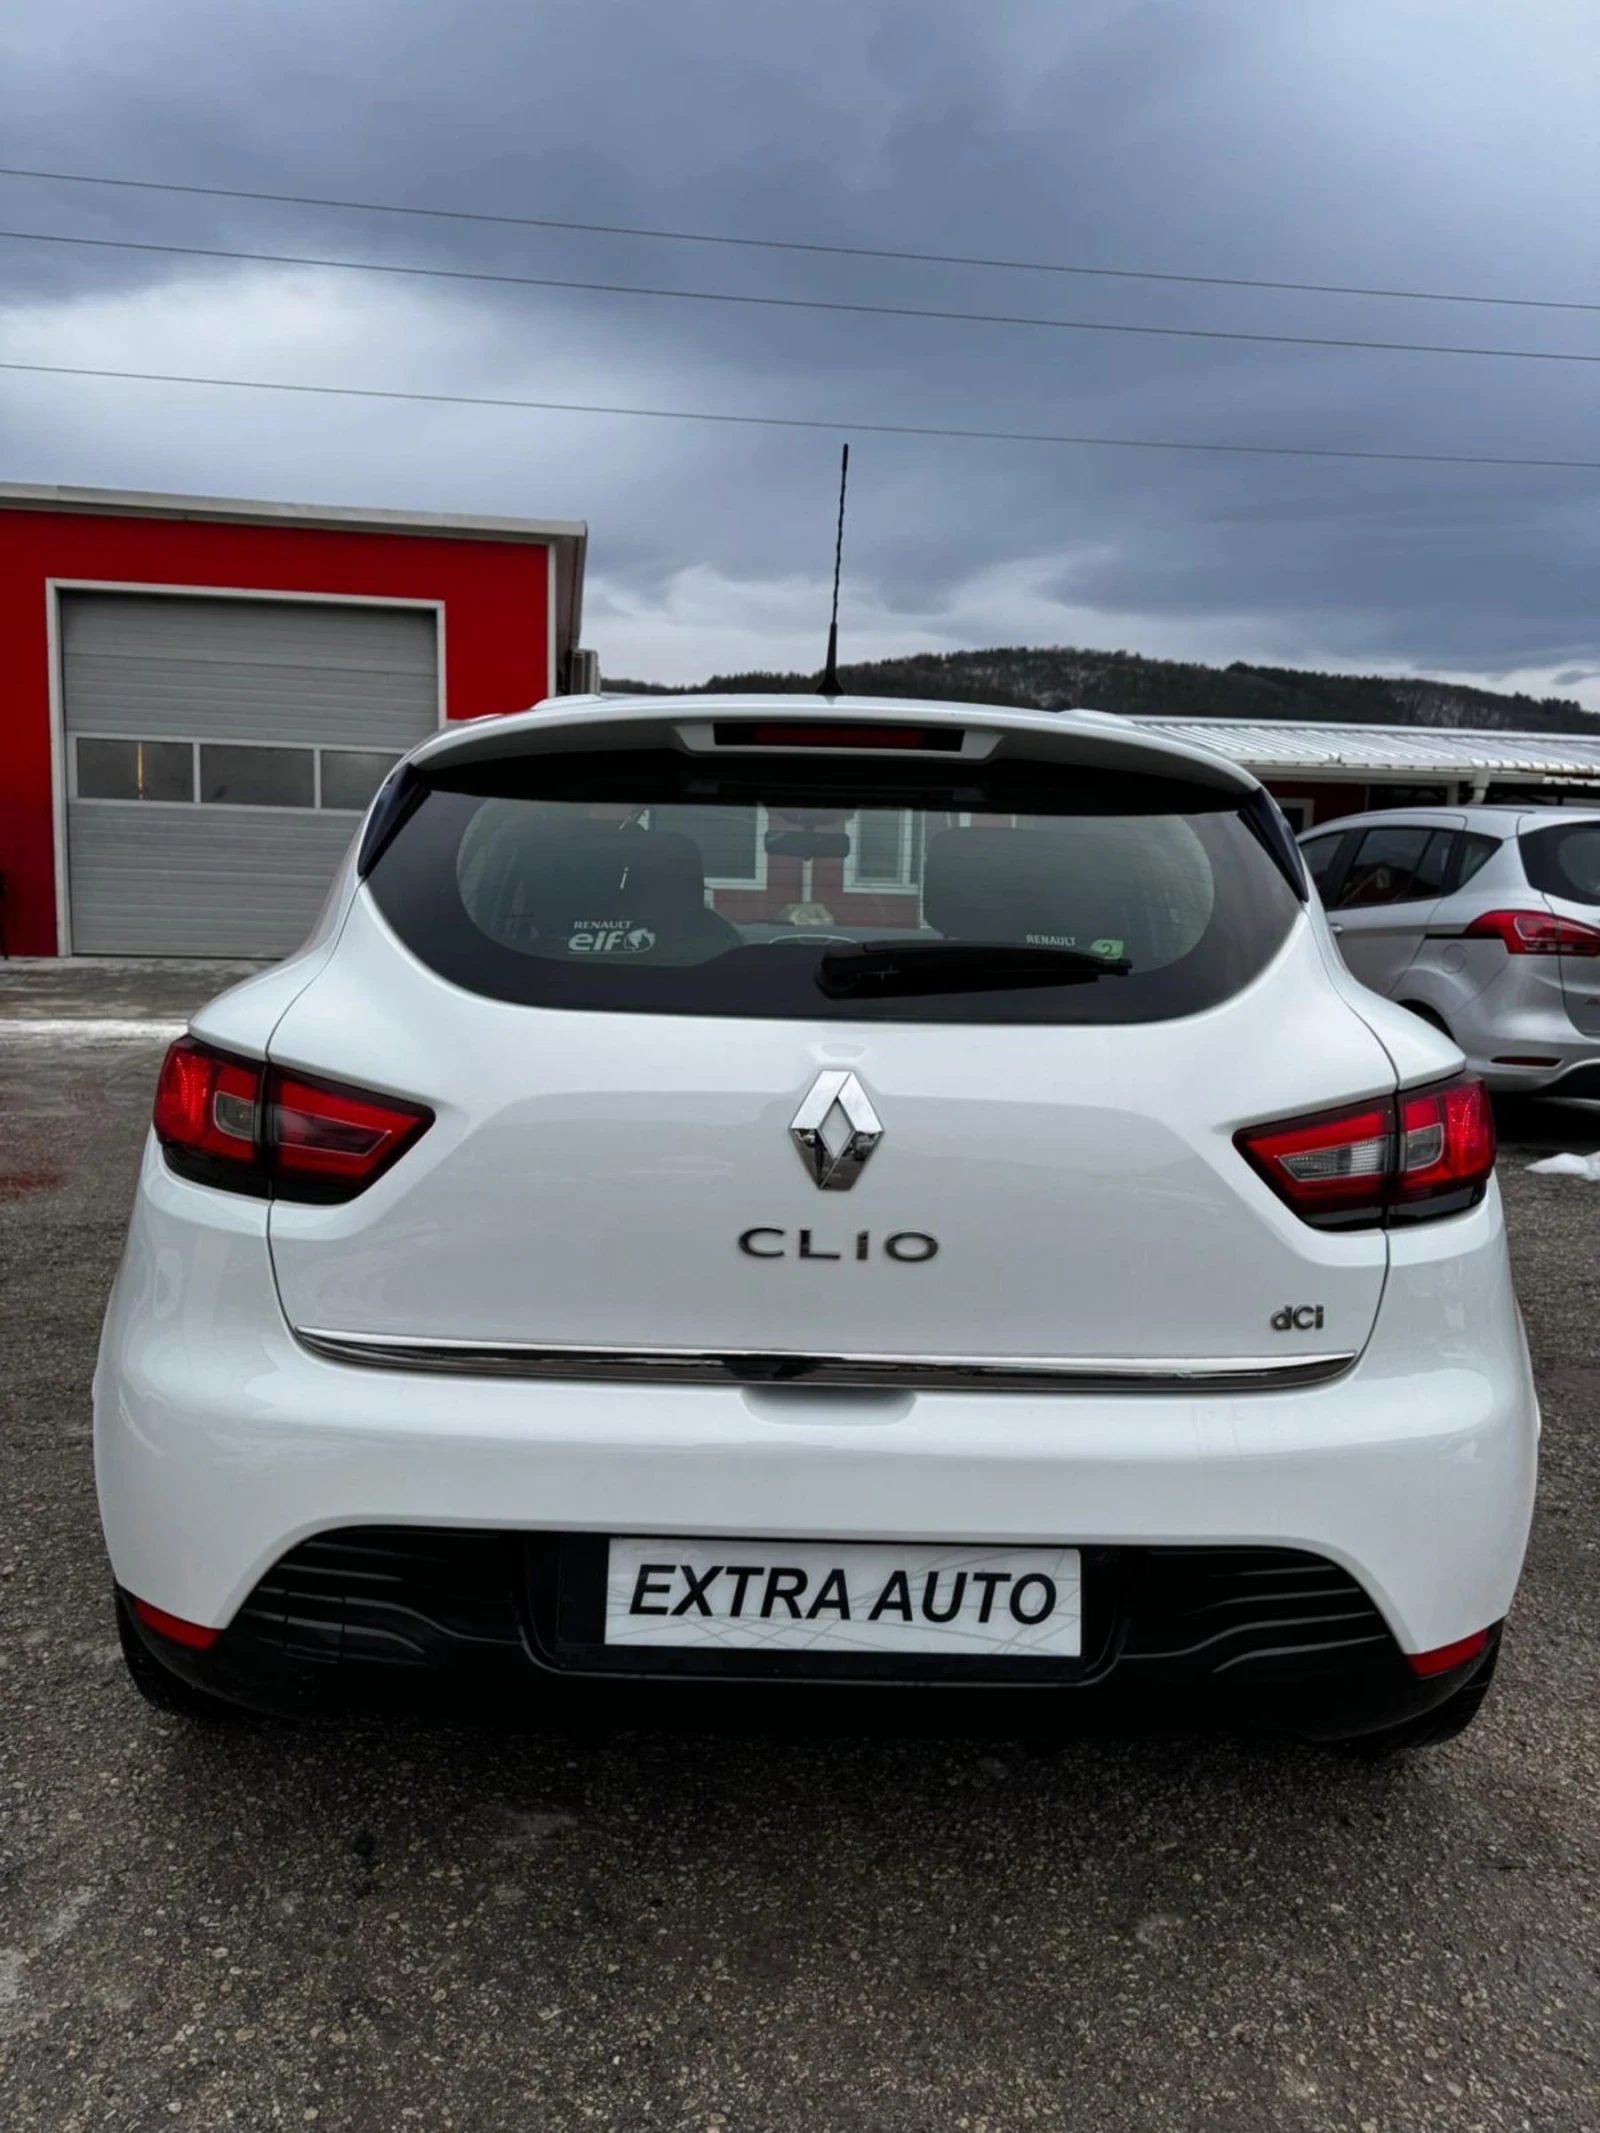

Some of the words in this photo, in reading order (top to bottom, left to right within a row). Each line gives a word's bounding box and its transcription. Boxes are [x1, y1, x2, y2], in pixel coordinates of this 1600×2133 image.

[573, 920, 633, 929] RENAULT
[568, 931, 625, 951] elf
[1026, 934, 1076, 946] RENAULT
[738, 1227, 938, 1262] CLIO
[629, 1564, 851, 1620] EXTRA
[868, 1570, 1057, 1625] AUTO
